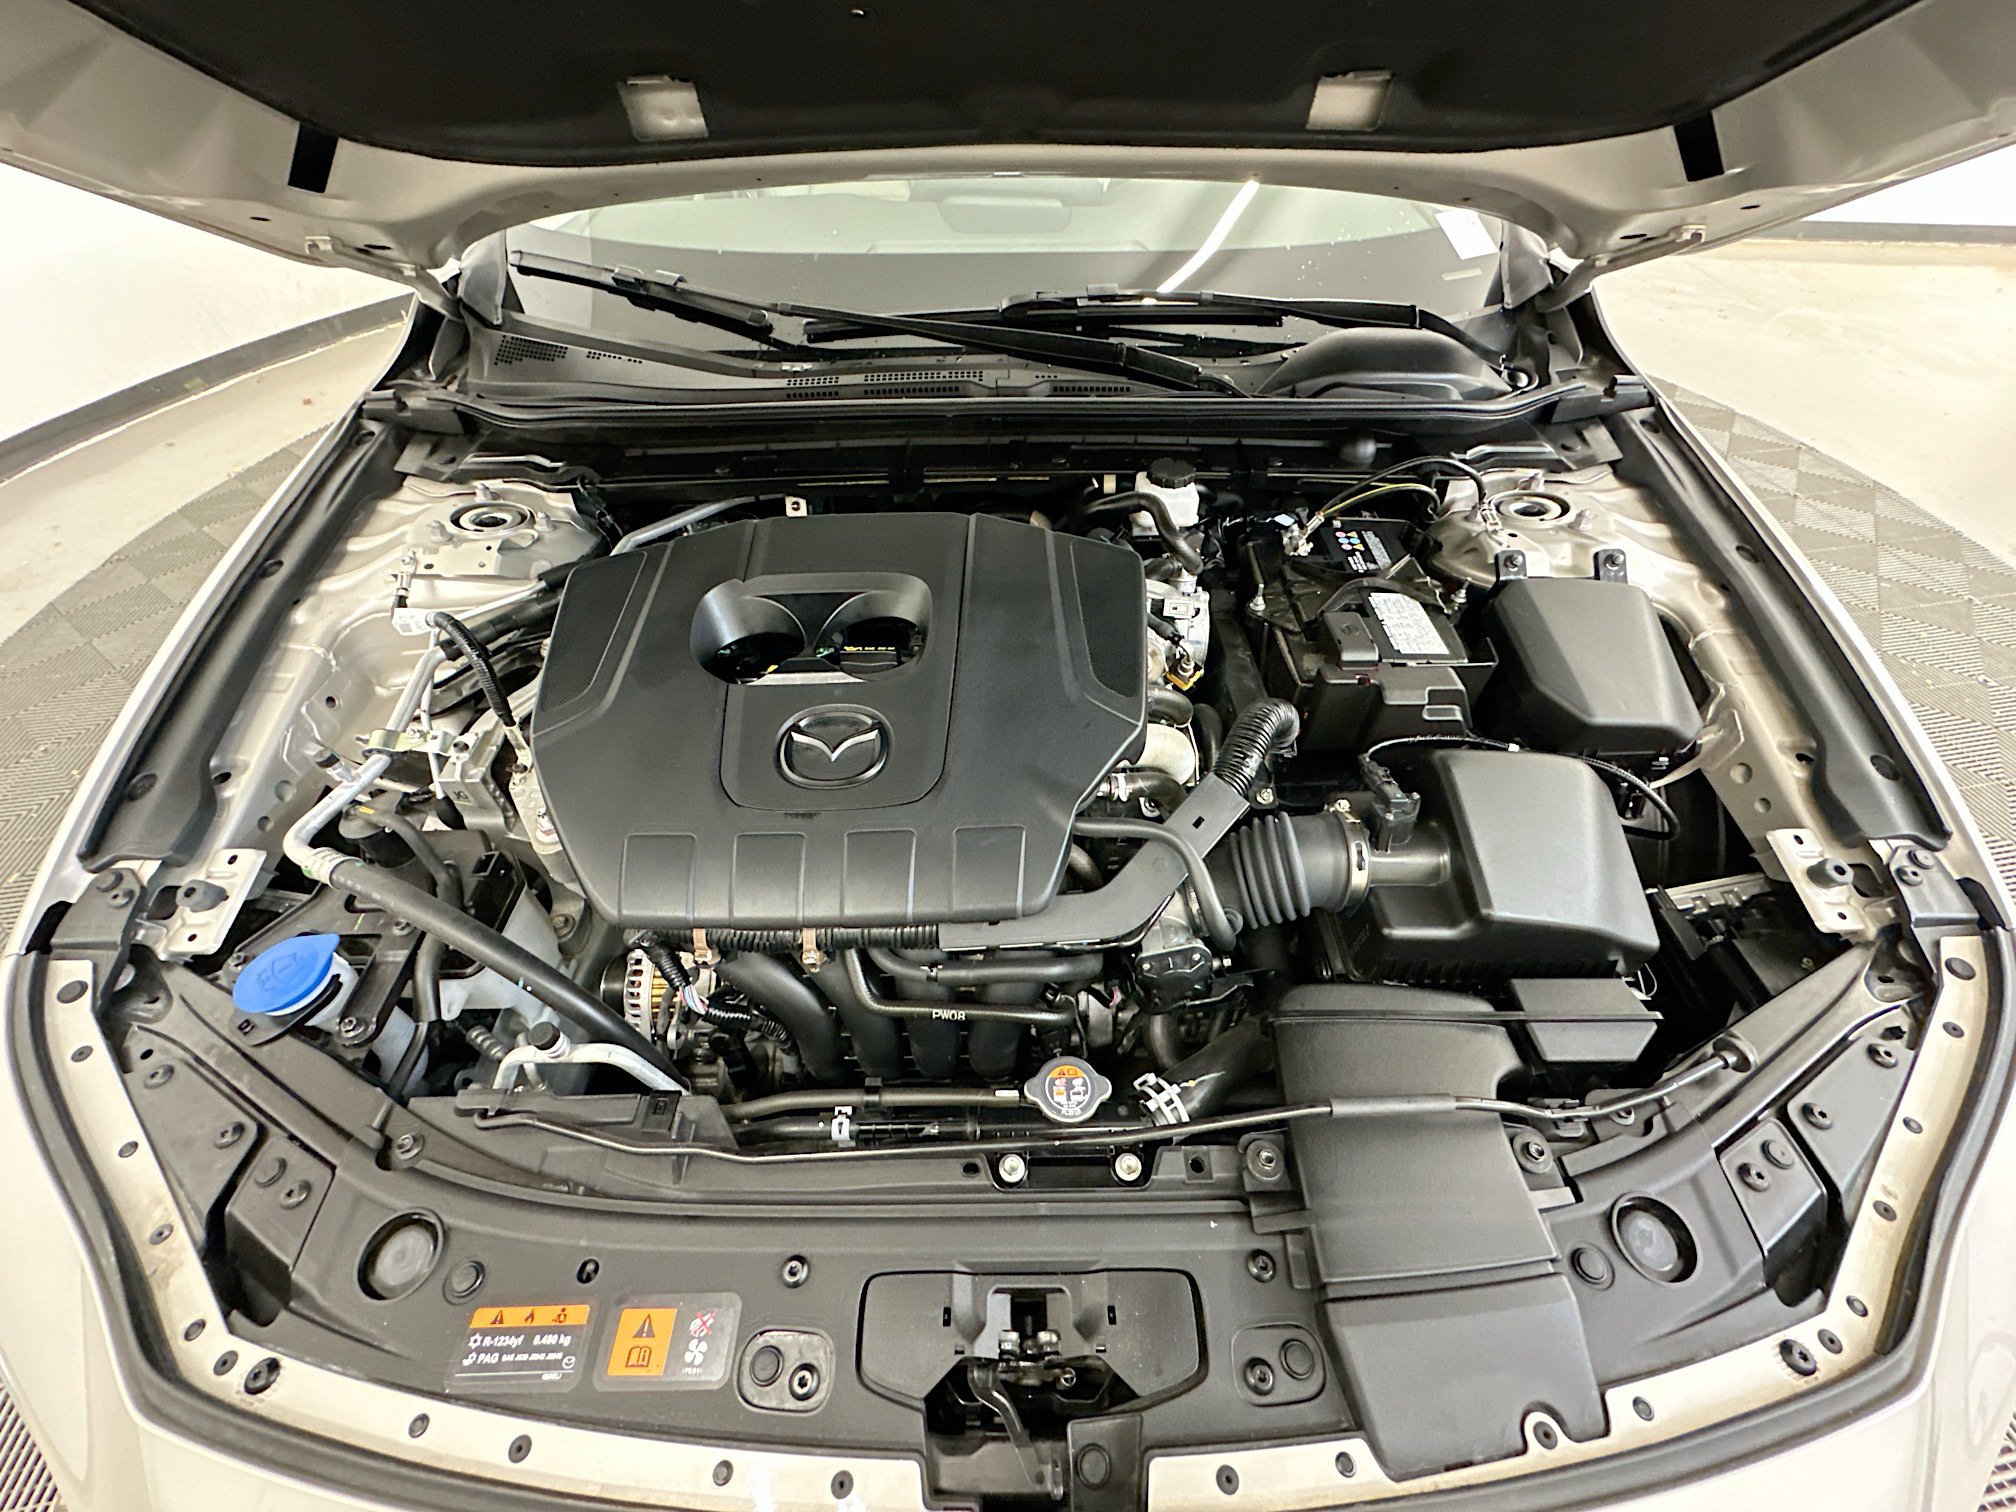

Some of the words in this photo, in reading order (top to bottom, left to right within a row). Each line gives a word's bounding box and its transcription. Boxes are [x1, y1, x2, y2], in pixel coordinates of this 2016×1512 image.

[932, 1008, 966, 1022] PW08
[482, 1335, 524, 1348] R-1234yf
[558, 1333, 572, 1347] kg
[477, 1352, 500, 1364] PAG
